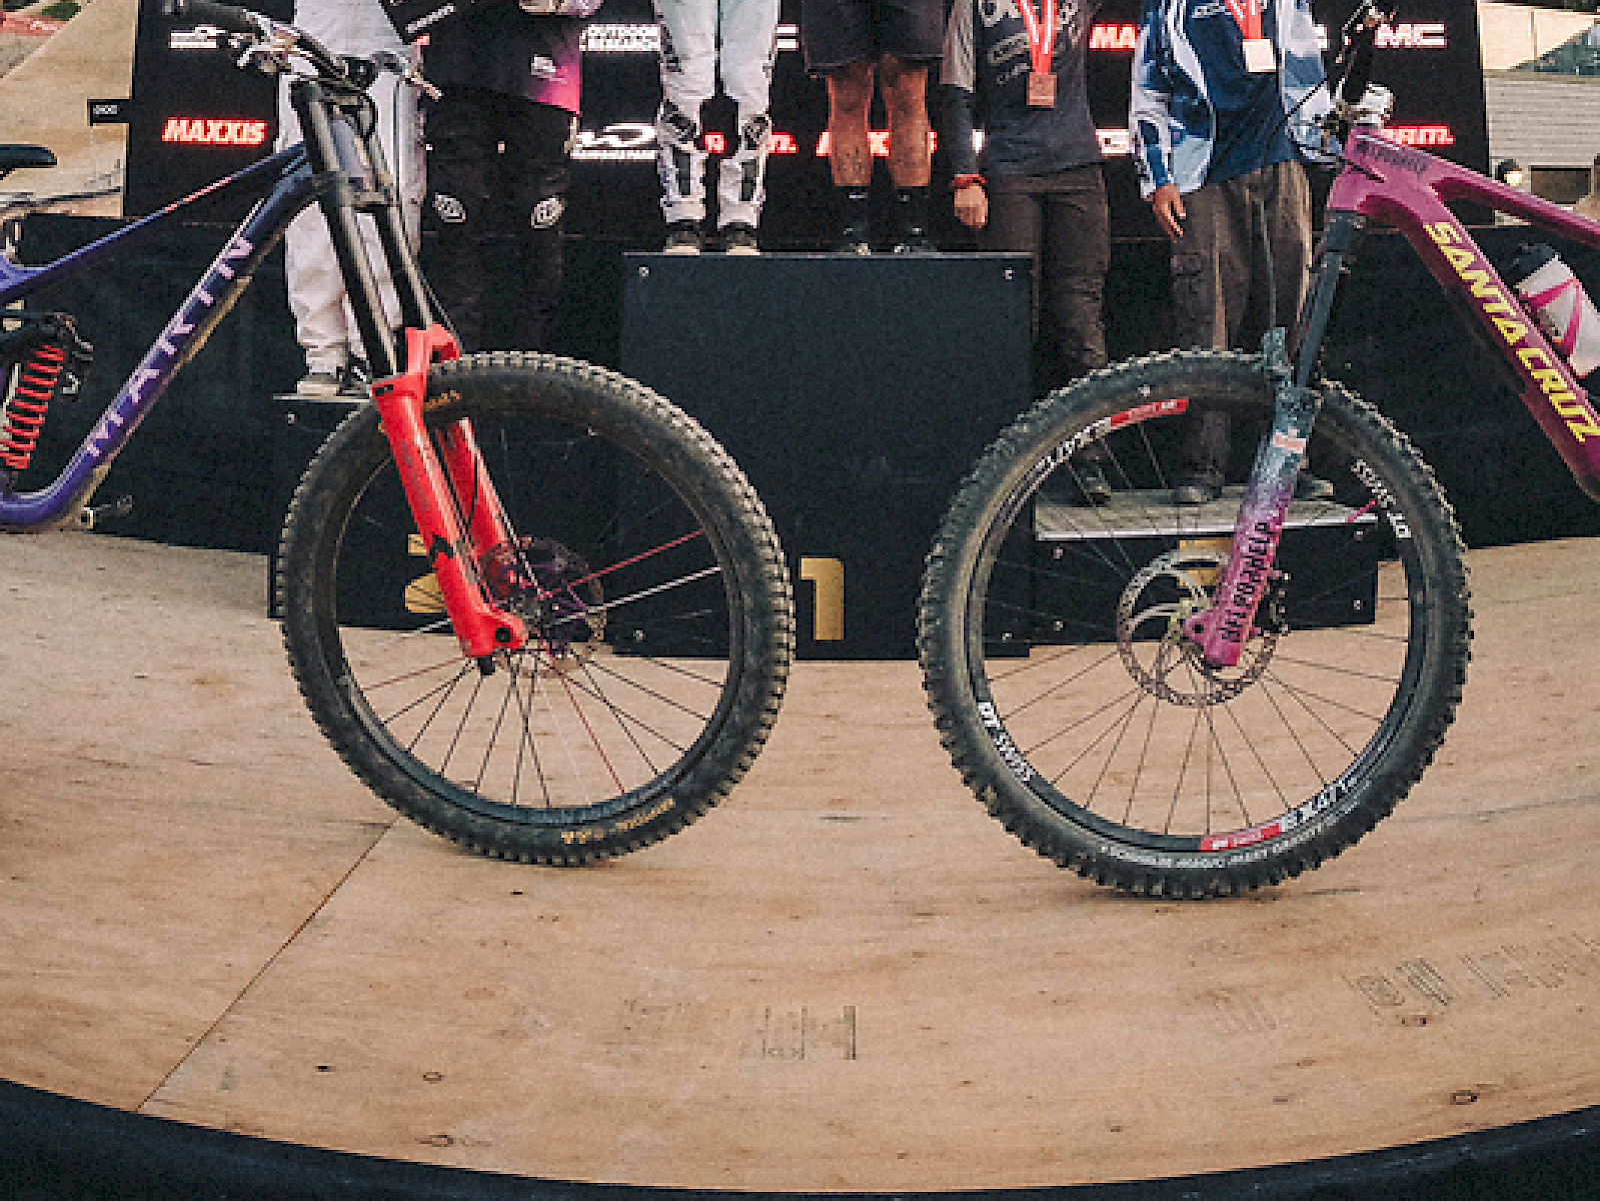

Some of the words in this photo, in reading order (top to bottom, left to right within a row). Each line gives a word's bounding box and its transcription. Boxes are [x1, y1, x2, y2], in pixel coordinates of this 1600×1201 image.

[1375, 24, 1447, 49] MC
[161, 116, 267, 145] MAXXIS
[1423, 220, 1530, 346] SANTA
[1517, 347, 1600, 445] CRUZ
[1350, 459, 1397, 509] SWISS
[1386, 509, 1412, 540] DT
[800, 557, 844, 642] 1
[977, 701, 1002, 734] DT
[994, 731, 1037, 784] SWISS
